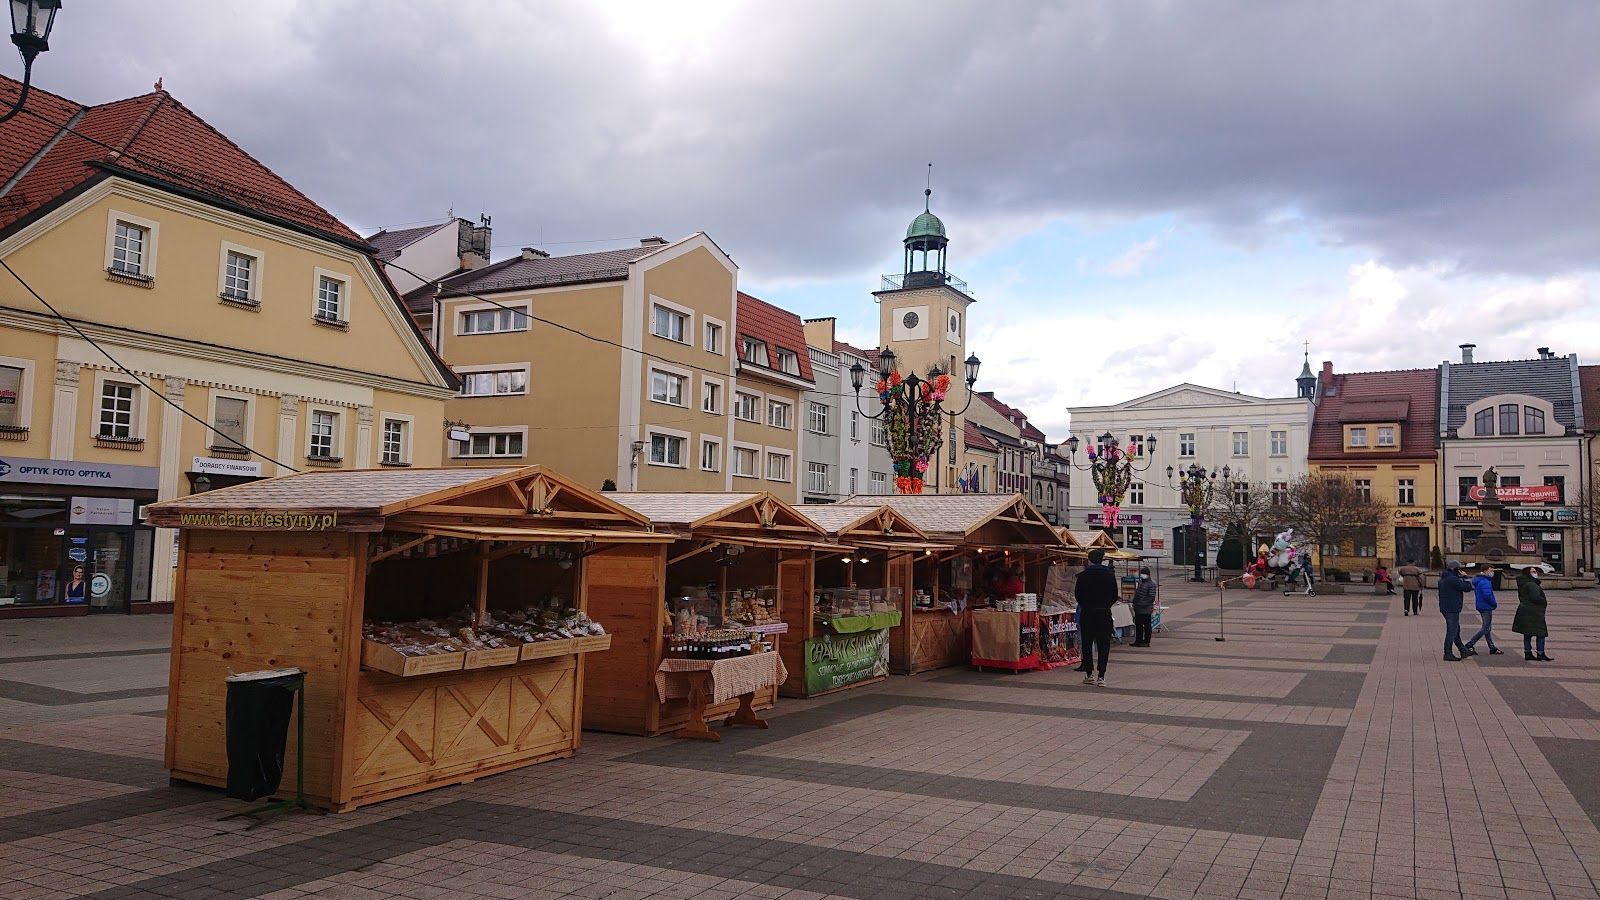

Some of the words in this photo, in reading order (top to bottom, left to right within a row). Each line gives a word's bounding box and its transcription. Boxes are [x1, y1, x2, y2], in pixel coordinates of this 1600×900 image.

[199, 461, 226, 470] DORADCY
[19, 466, 49, 475] OPTYK
[53, 468, 75, 477] FOTO
[78, 470, 111, 478] OPTYKA
[1394, 510, 1426, 519] Cocoon
[180, 510, 338, 531] www.darekfestyny.pl
